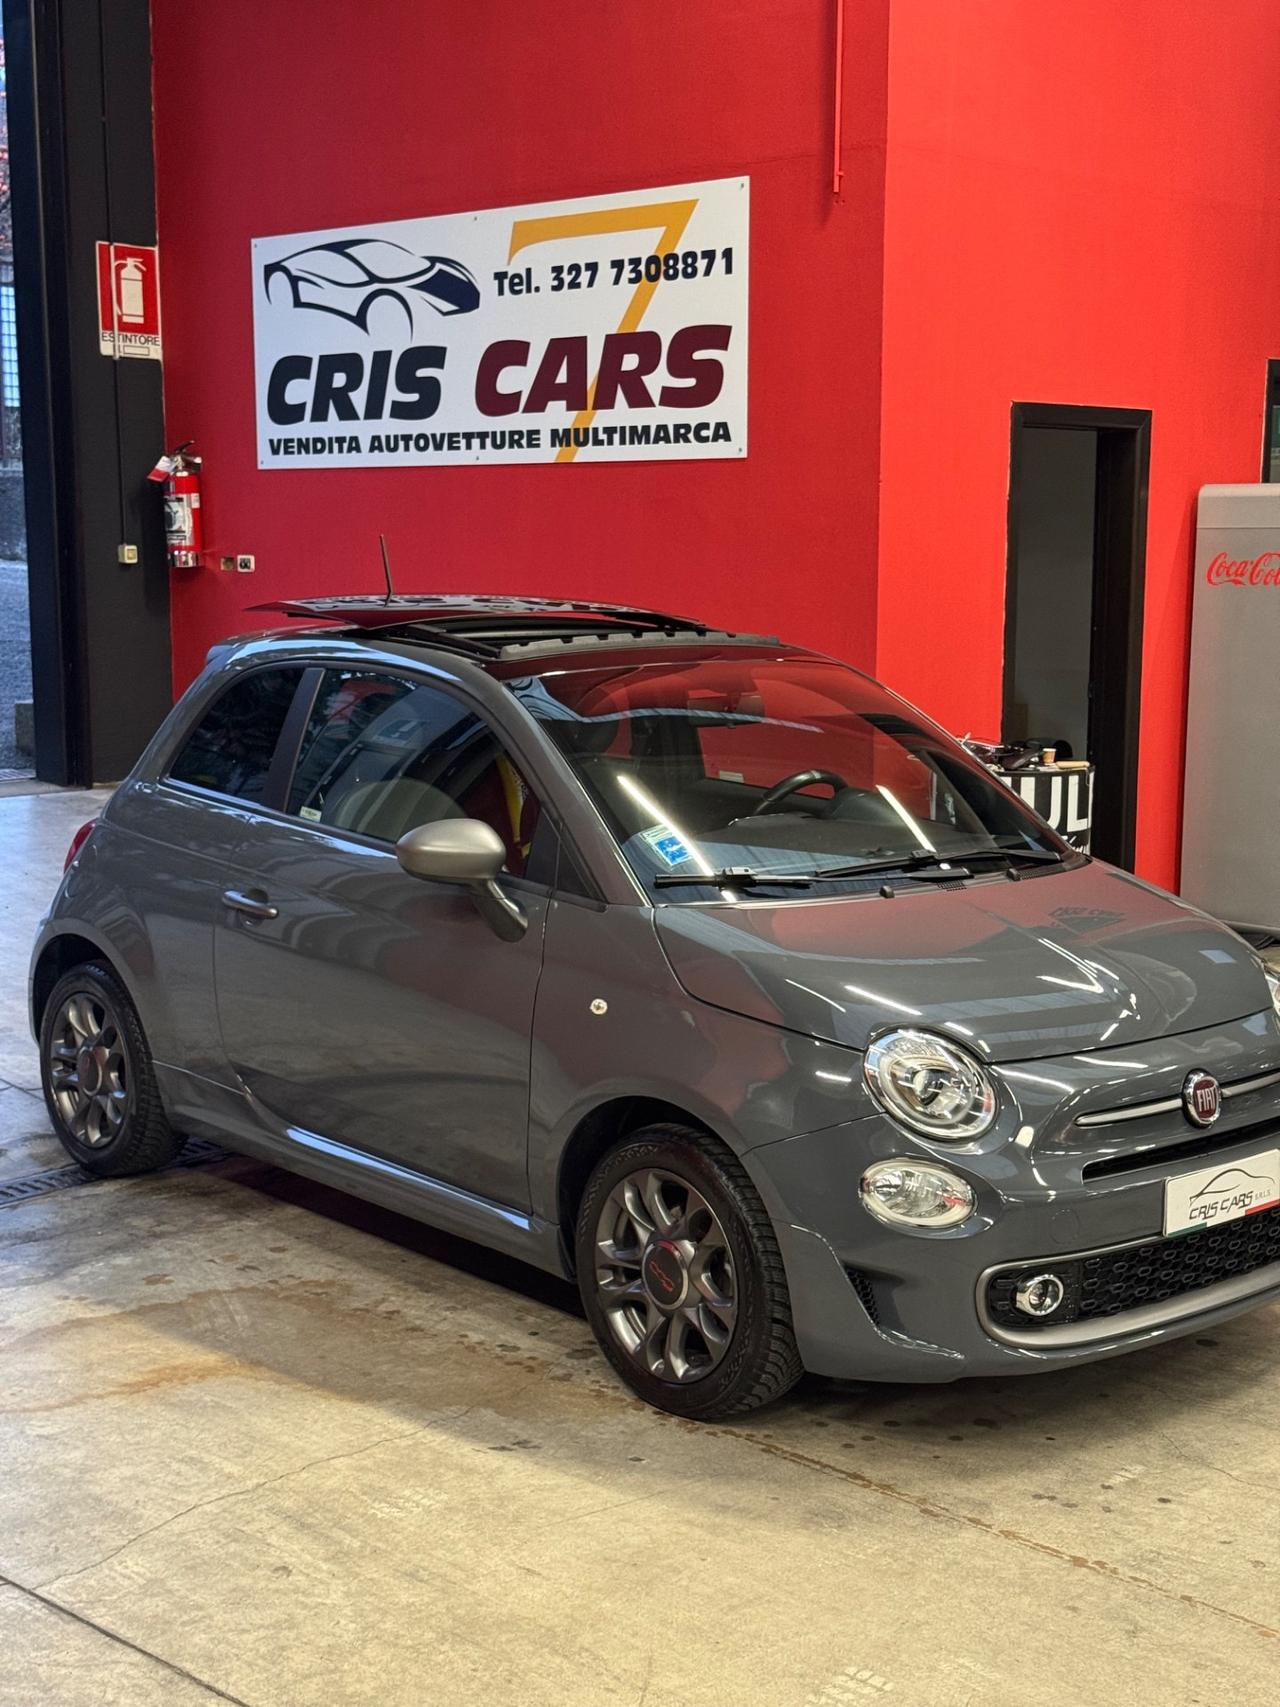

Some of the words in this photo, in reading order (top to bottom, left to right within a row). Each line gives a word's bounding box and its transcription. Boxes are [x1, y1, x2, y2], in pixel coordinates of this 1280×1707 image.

[493, 270, 541, 297] Tel.
[550, 261, 599, 292] 327
[610, 247, 733, 286] 7308871
[266, 345, 448, 426] CRIS
[474, 324, 733, 417] CARS
[268, 435, 362, 456] VENDITA
[368, 429, 541, 454] AUTOVETTURE
[550, 421, 732, 448] MULTIMARCA
[1196, 1086, 1216, 1112] FIAT
[1189, 1201, 1219, 1220] CRIS
[1220, 1190, 1254, 1213] CARS
